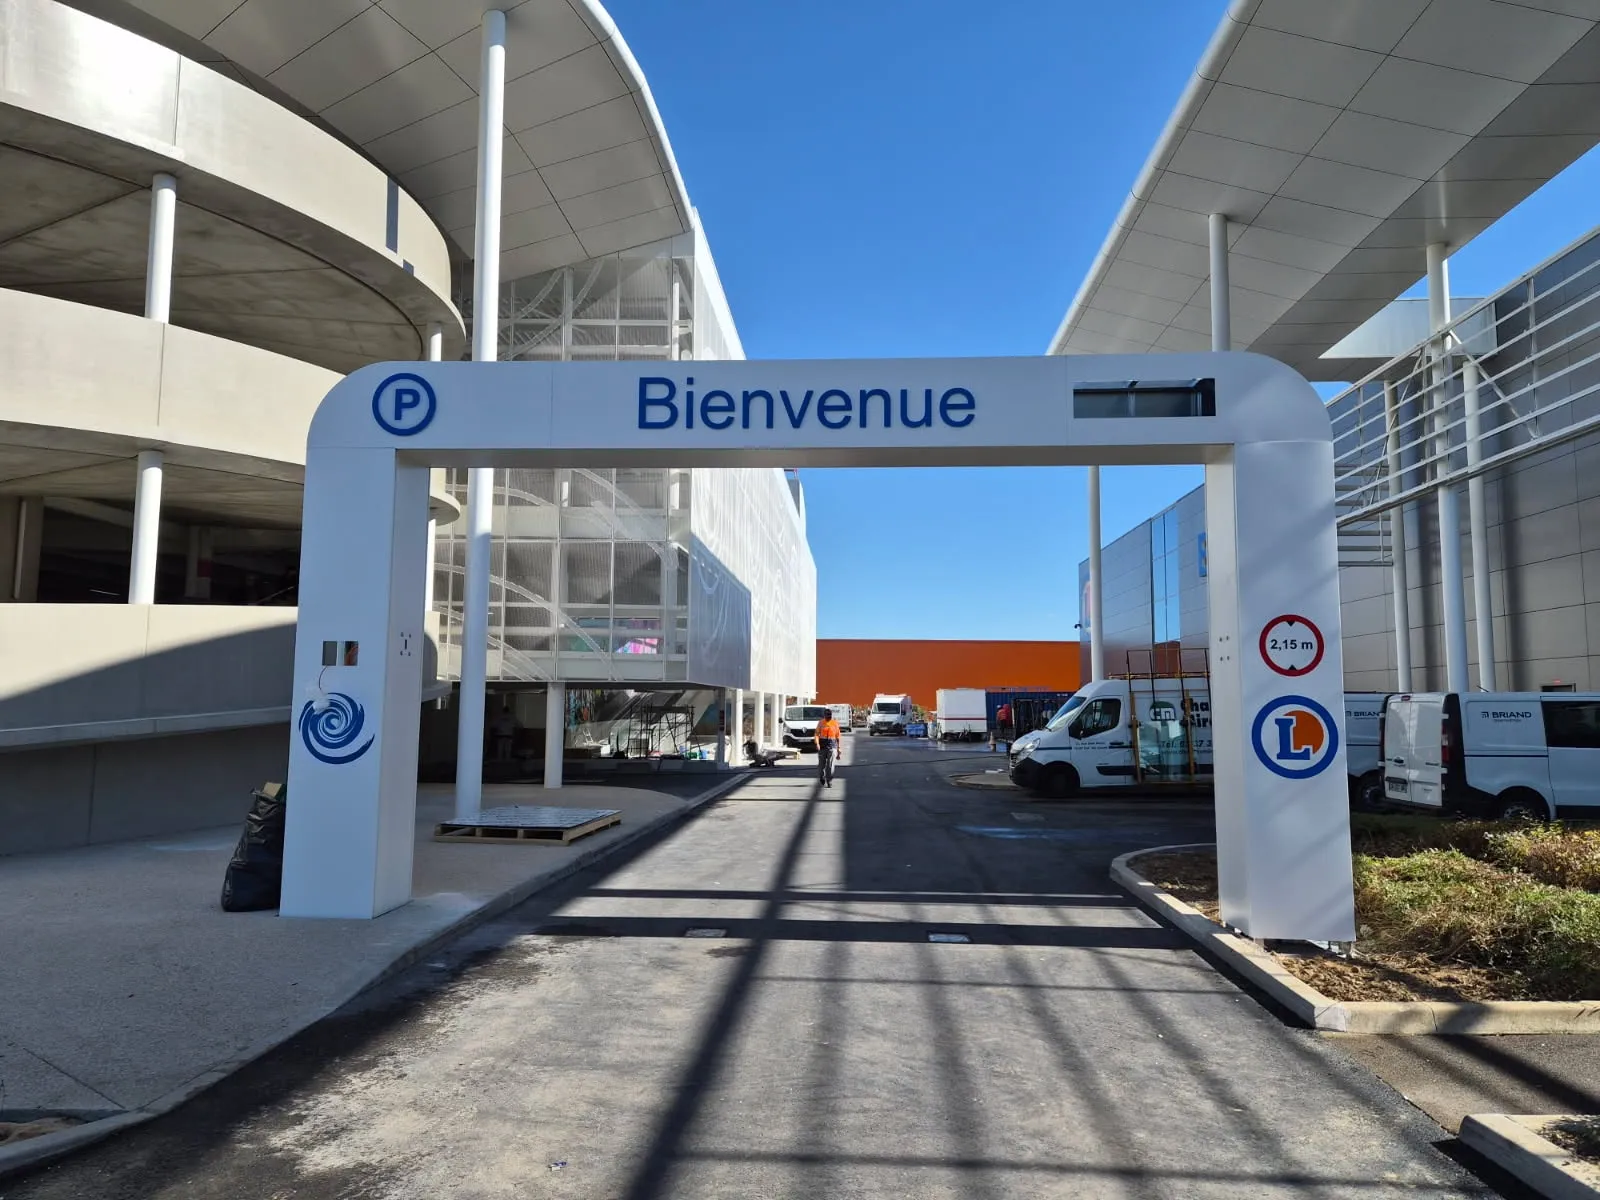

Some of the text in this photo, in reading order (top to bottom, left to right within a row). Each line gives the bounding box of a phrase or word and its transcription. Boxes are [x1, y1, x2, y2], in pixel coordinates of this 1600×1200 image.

[394, 388, 420, 421] P
[638, 377, 976, 430] Bienvenue
[1270, 639, 1313, 651] 2,15 m
[1491, 711, 1532, 719] BRIAND
